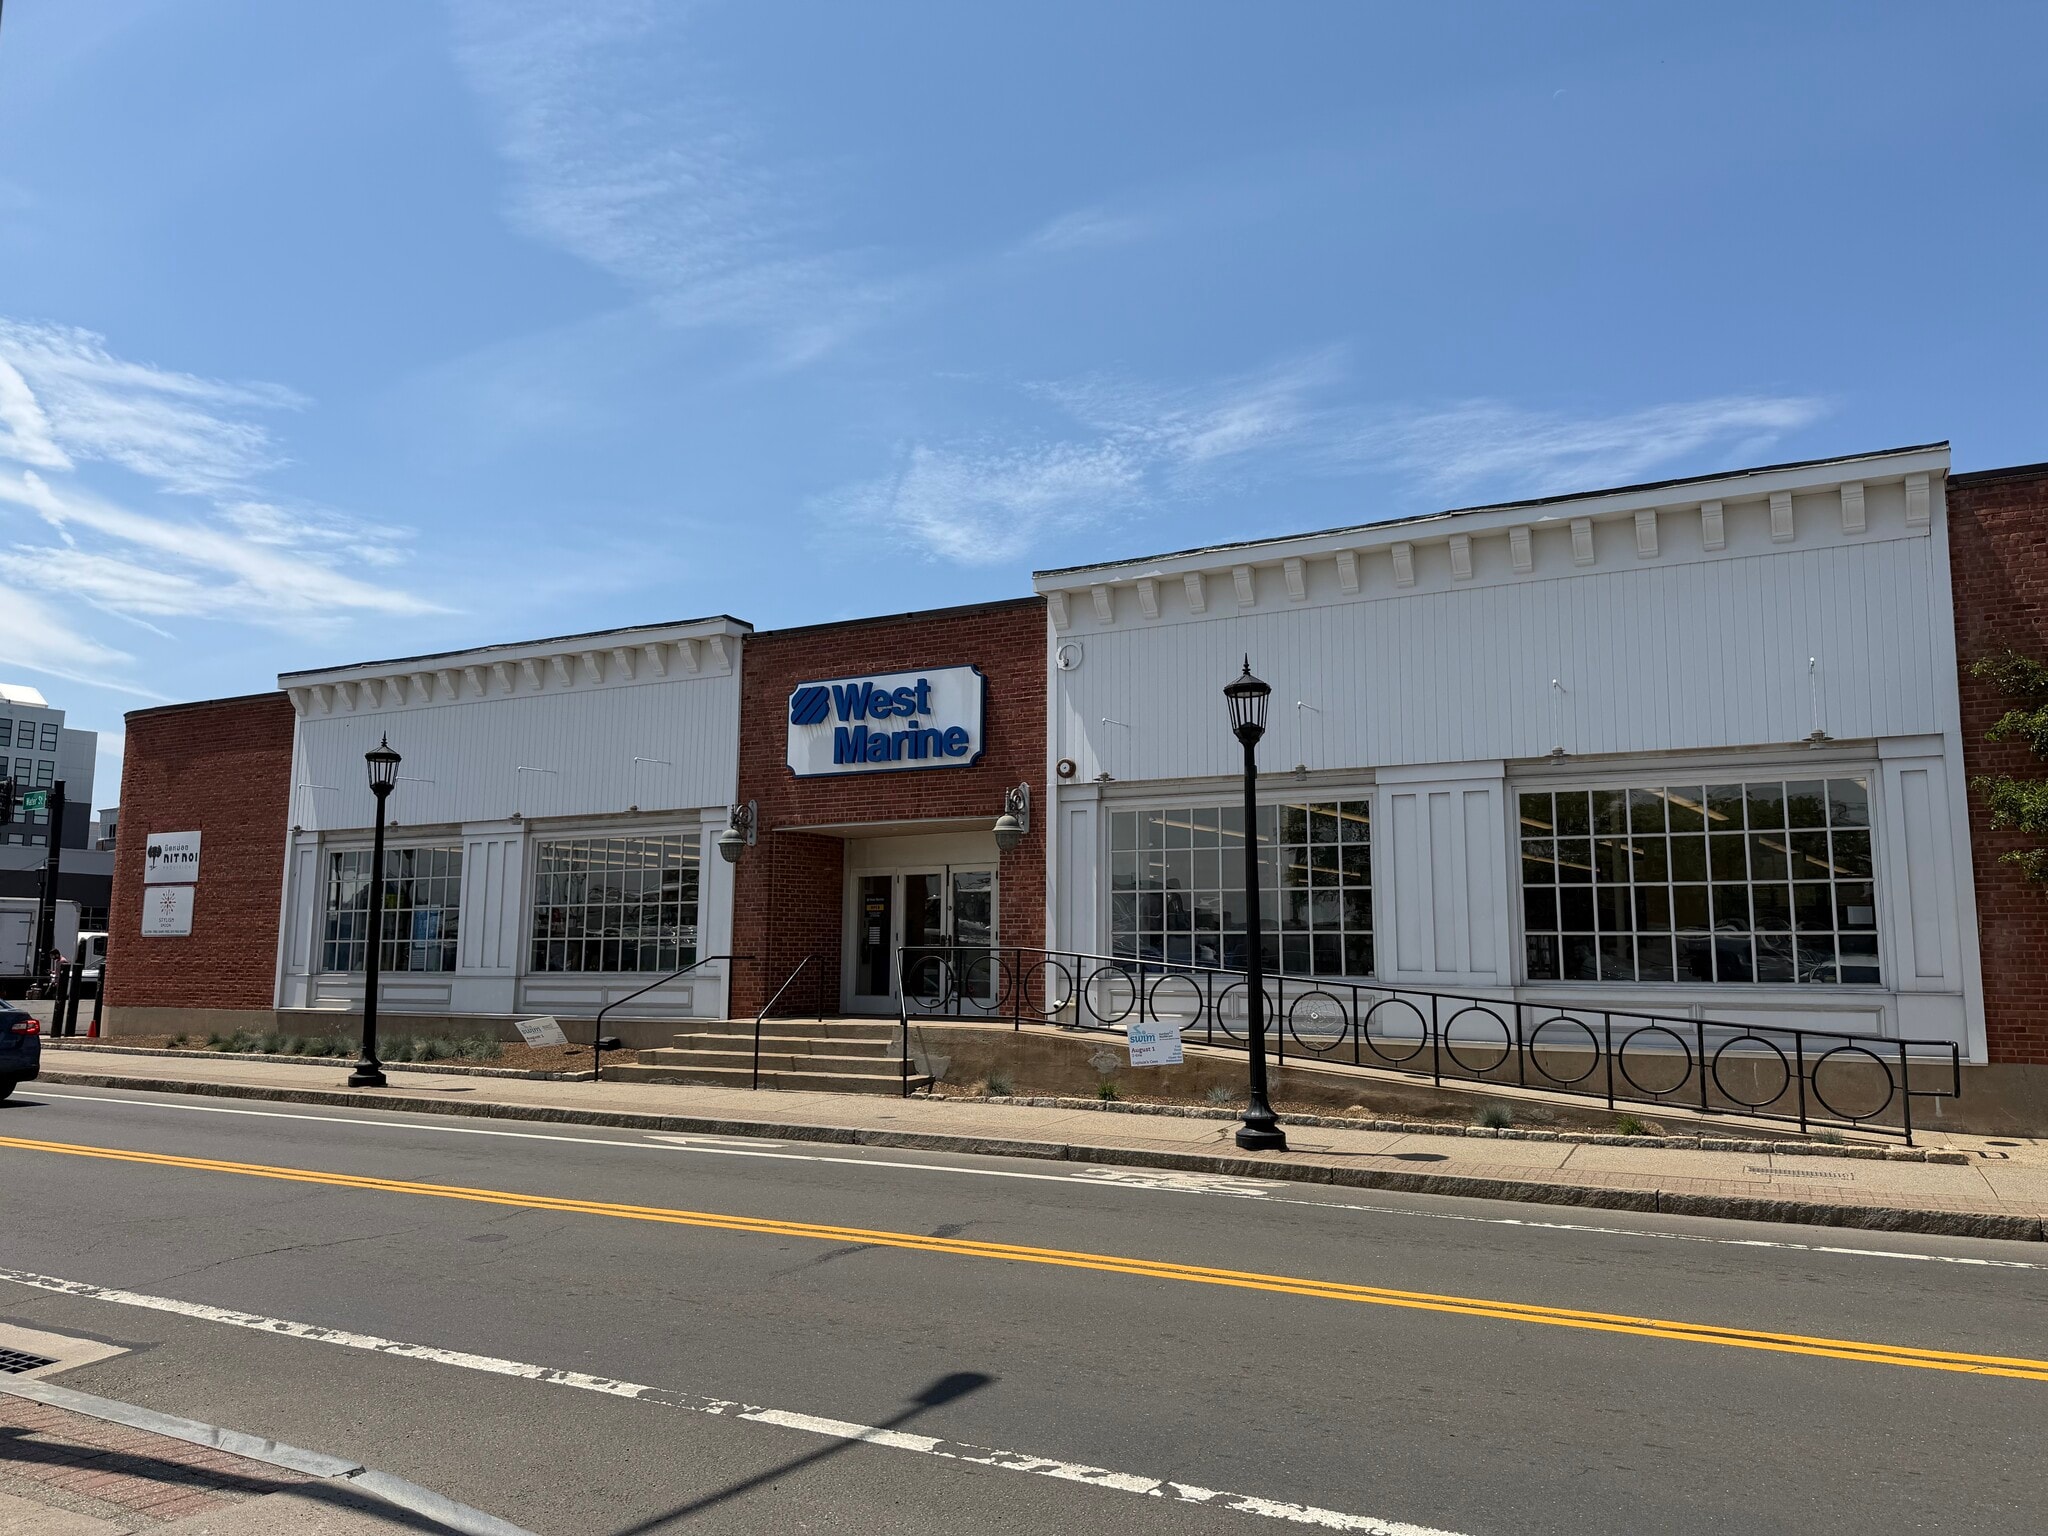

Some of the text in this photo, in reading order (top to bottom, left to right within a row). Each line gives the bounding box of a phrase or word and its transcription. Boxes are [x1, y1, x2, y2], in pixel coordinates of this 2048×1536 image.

[832, 678, 931, 721] West
[833, 720, 970, 765] Marine
[1130, 1034, 1155, 1043] swim
